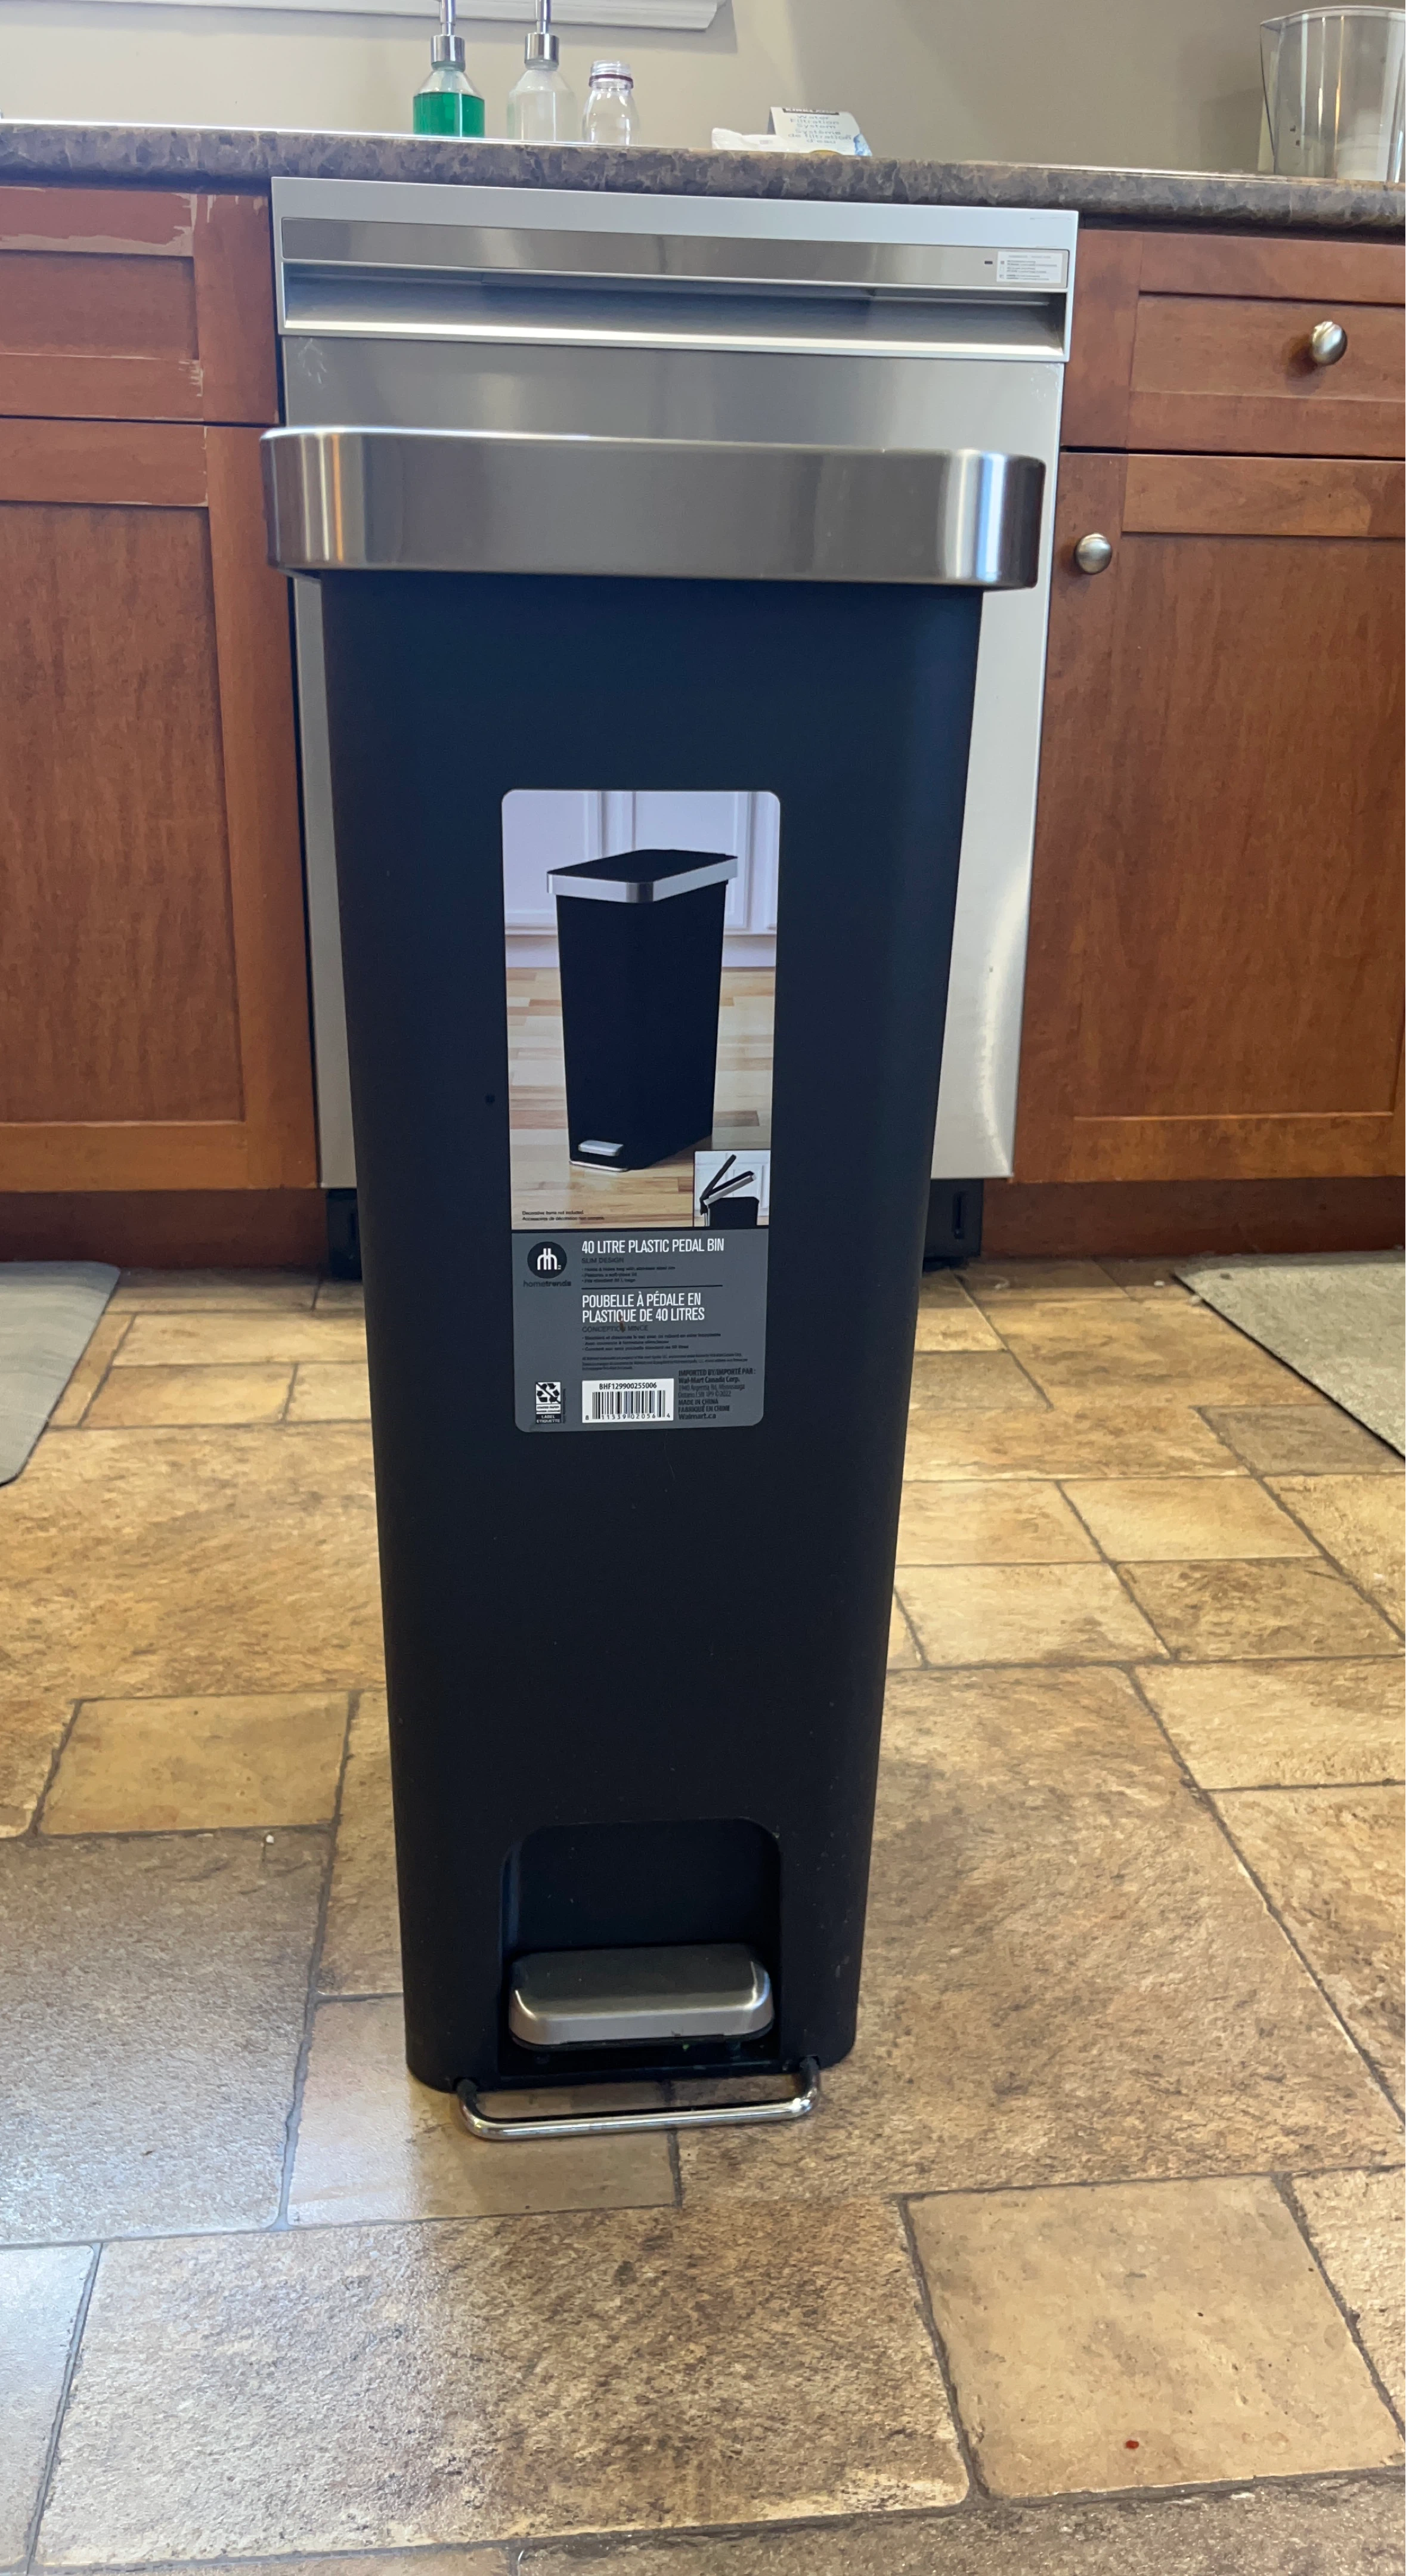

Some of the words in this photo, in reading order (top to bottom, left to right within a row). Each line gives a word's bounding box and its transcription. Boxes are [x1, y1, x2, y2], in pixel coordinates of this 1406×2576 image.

[581, 1240, 594, 1253] 40
[597, 1240, 625, 1253] LITRE
[628, 1239, 669, 1253] PLASTIC
[672, 1239, 705, 1252] PEDAL
[707, 1238, 724, 1251] BIN
[582, 1294, 634, 1308] POUBELLE
[637, 1291, 644, 1306] À
[646, 1291, 685, 1306] PÉDALE
[687, 1293, 701, 1305] EN
[582, 1309, 636, 1323] PLASTIQUE
[640, 1308, 653, 1322] DE
[655, 1308, 668, 1321] 40
[671, 1307, 705, 1321] LITRES
